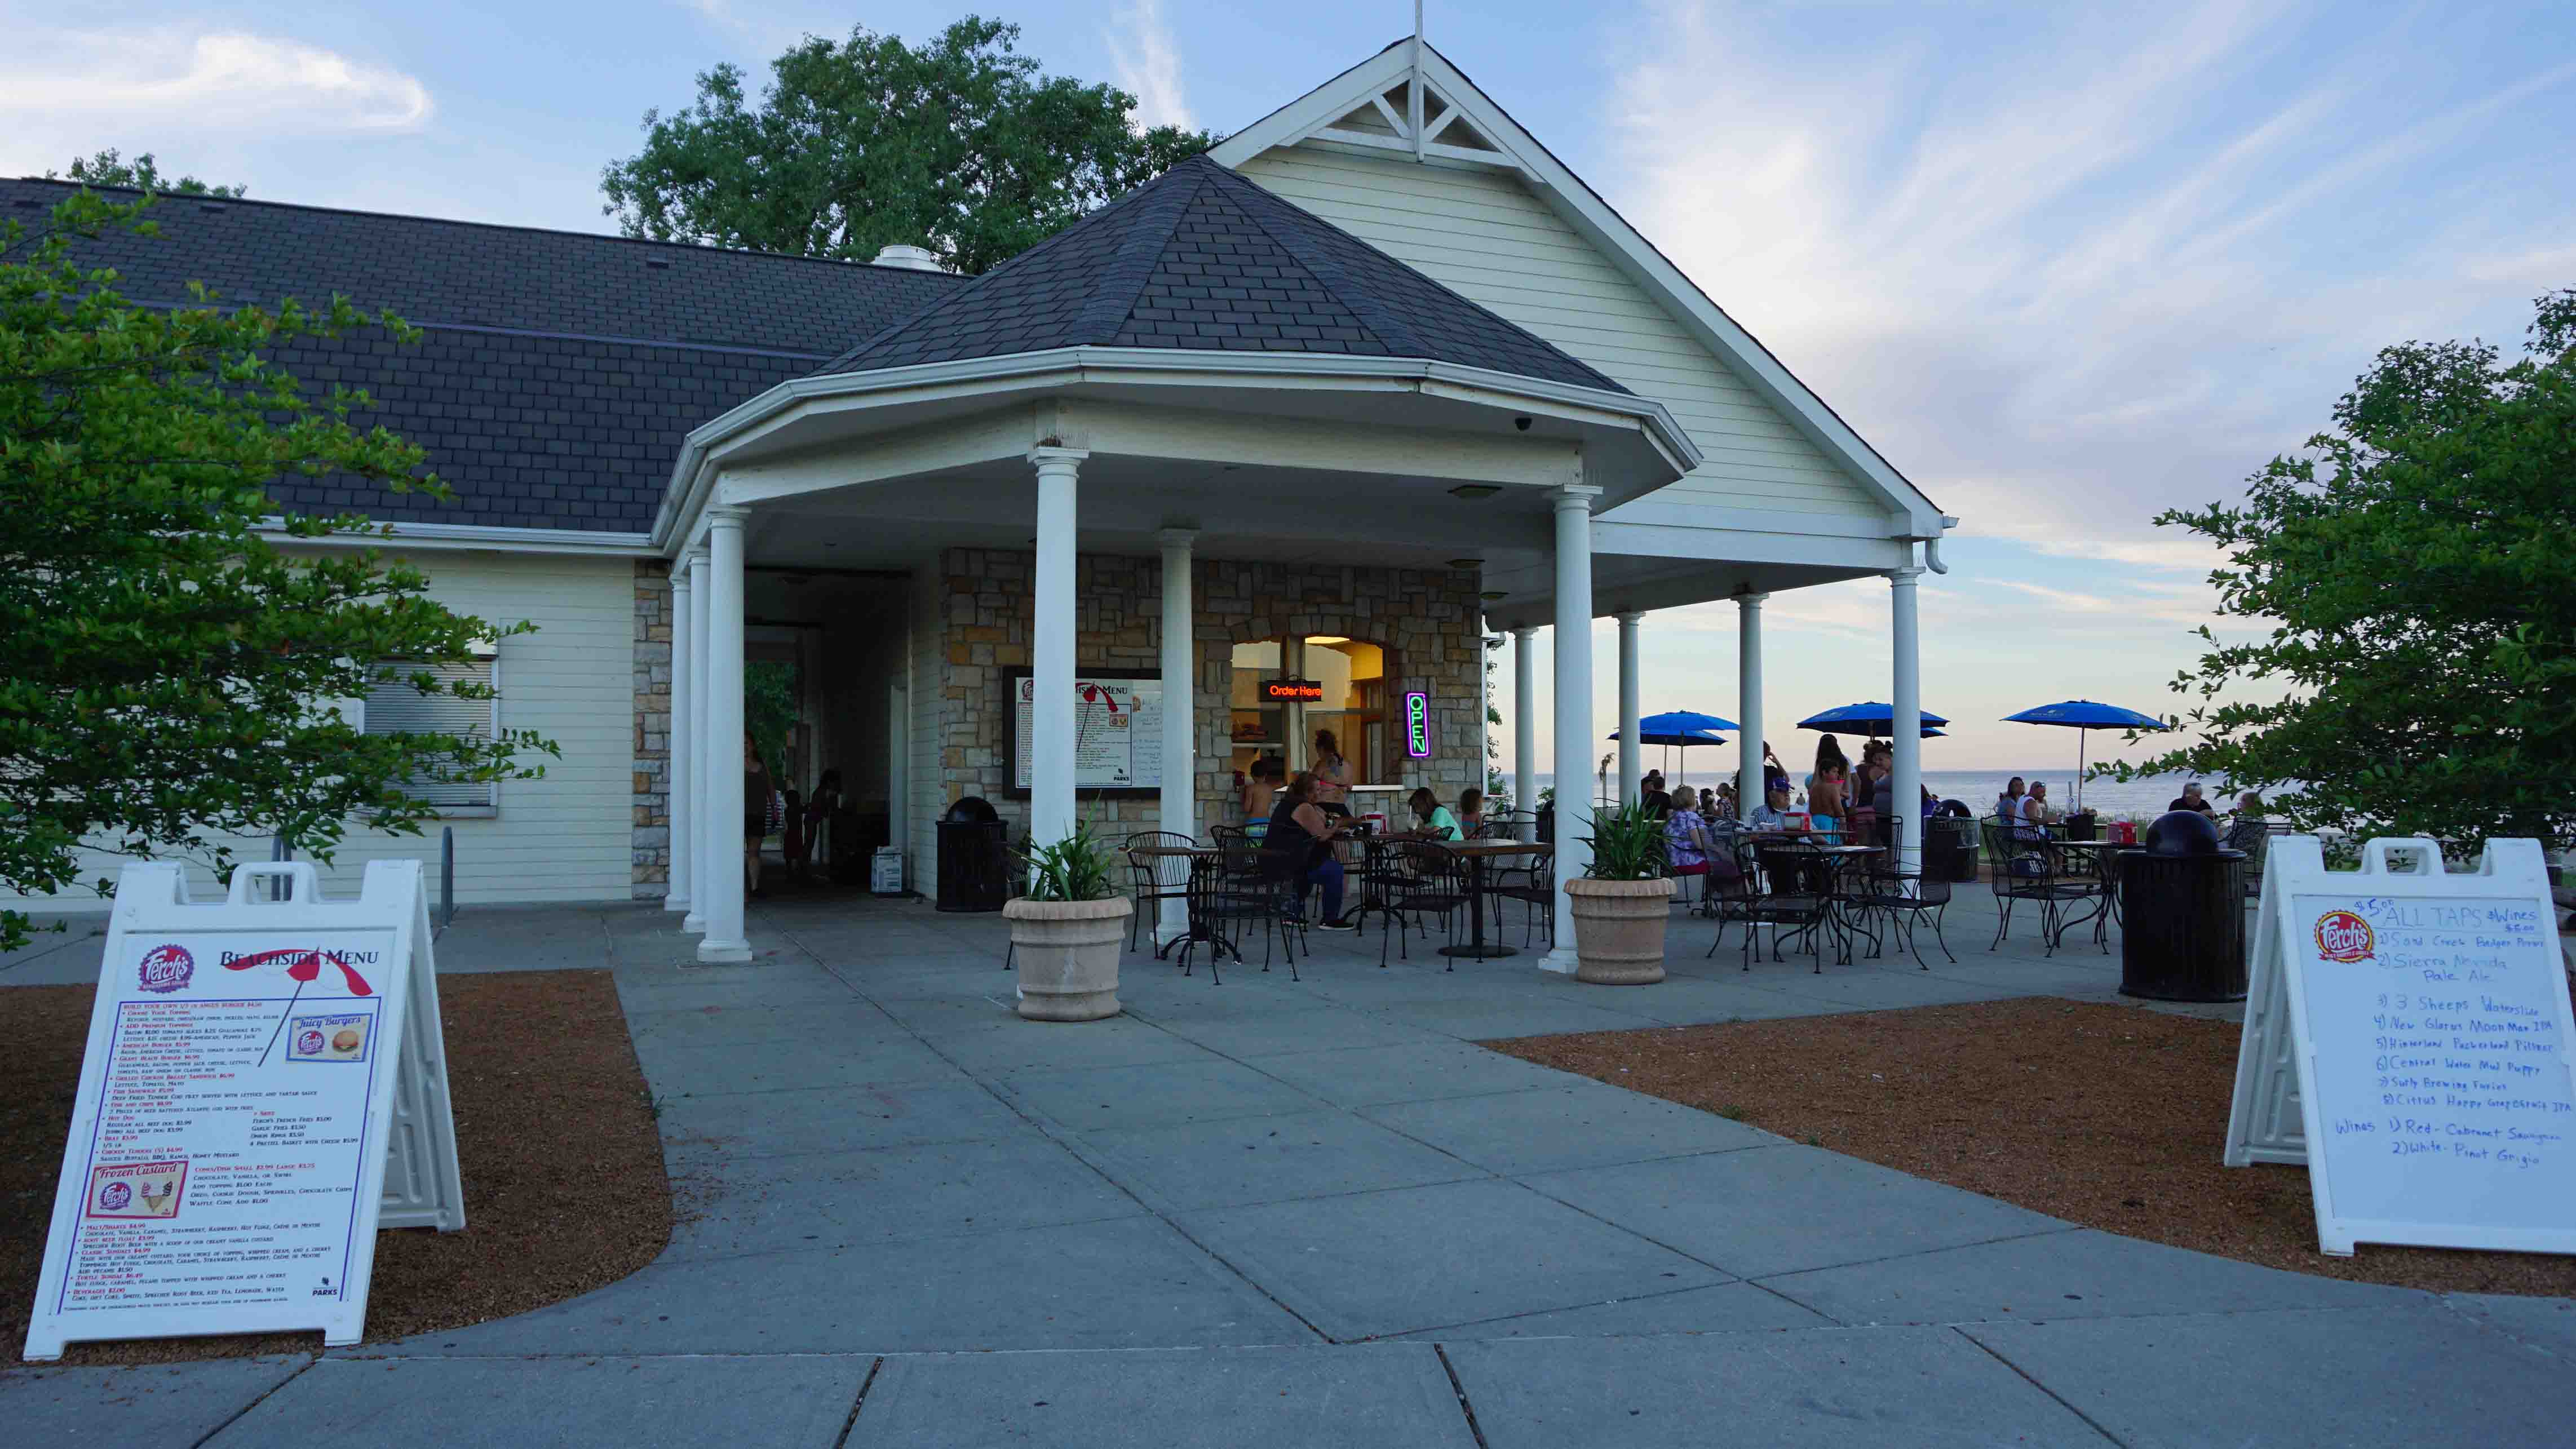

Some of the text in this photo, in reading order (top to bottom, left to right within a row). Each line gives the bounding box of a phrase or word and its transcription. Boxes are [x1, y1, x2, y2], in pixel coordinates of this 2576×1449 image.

[1103, 685, 1127, 694] MENU
[1270, 685, 1321, 697] Order Here
[1410, 696, 1426, 753] OPEN
[2384, 907, 2425, 927] ALL
[2431, 907, 2482, 928] TAPS
[2321, 916, 2367, 950] Ferch's
[145, 950, 188, 981] Ferch's
[2394, 953, 2446, 968] Sierra
[2424, 969, 2459, 982] Pale
[2397, 994, 2407, 1009] 3
[2419, 996, 2468, 1014] Sheeps
[2336, 1118, 2375, 1134] Wines
[99, 1163, 178, 1178] Frozen Custard
